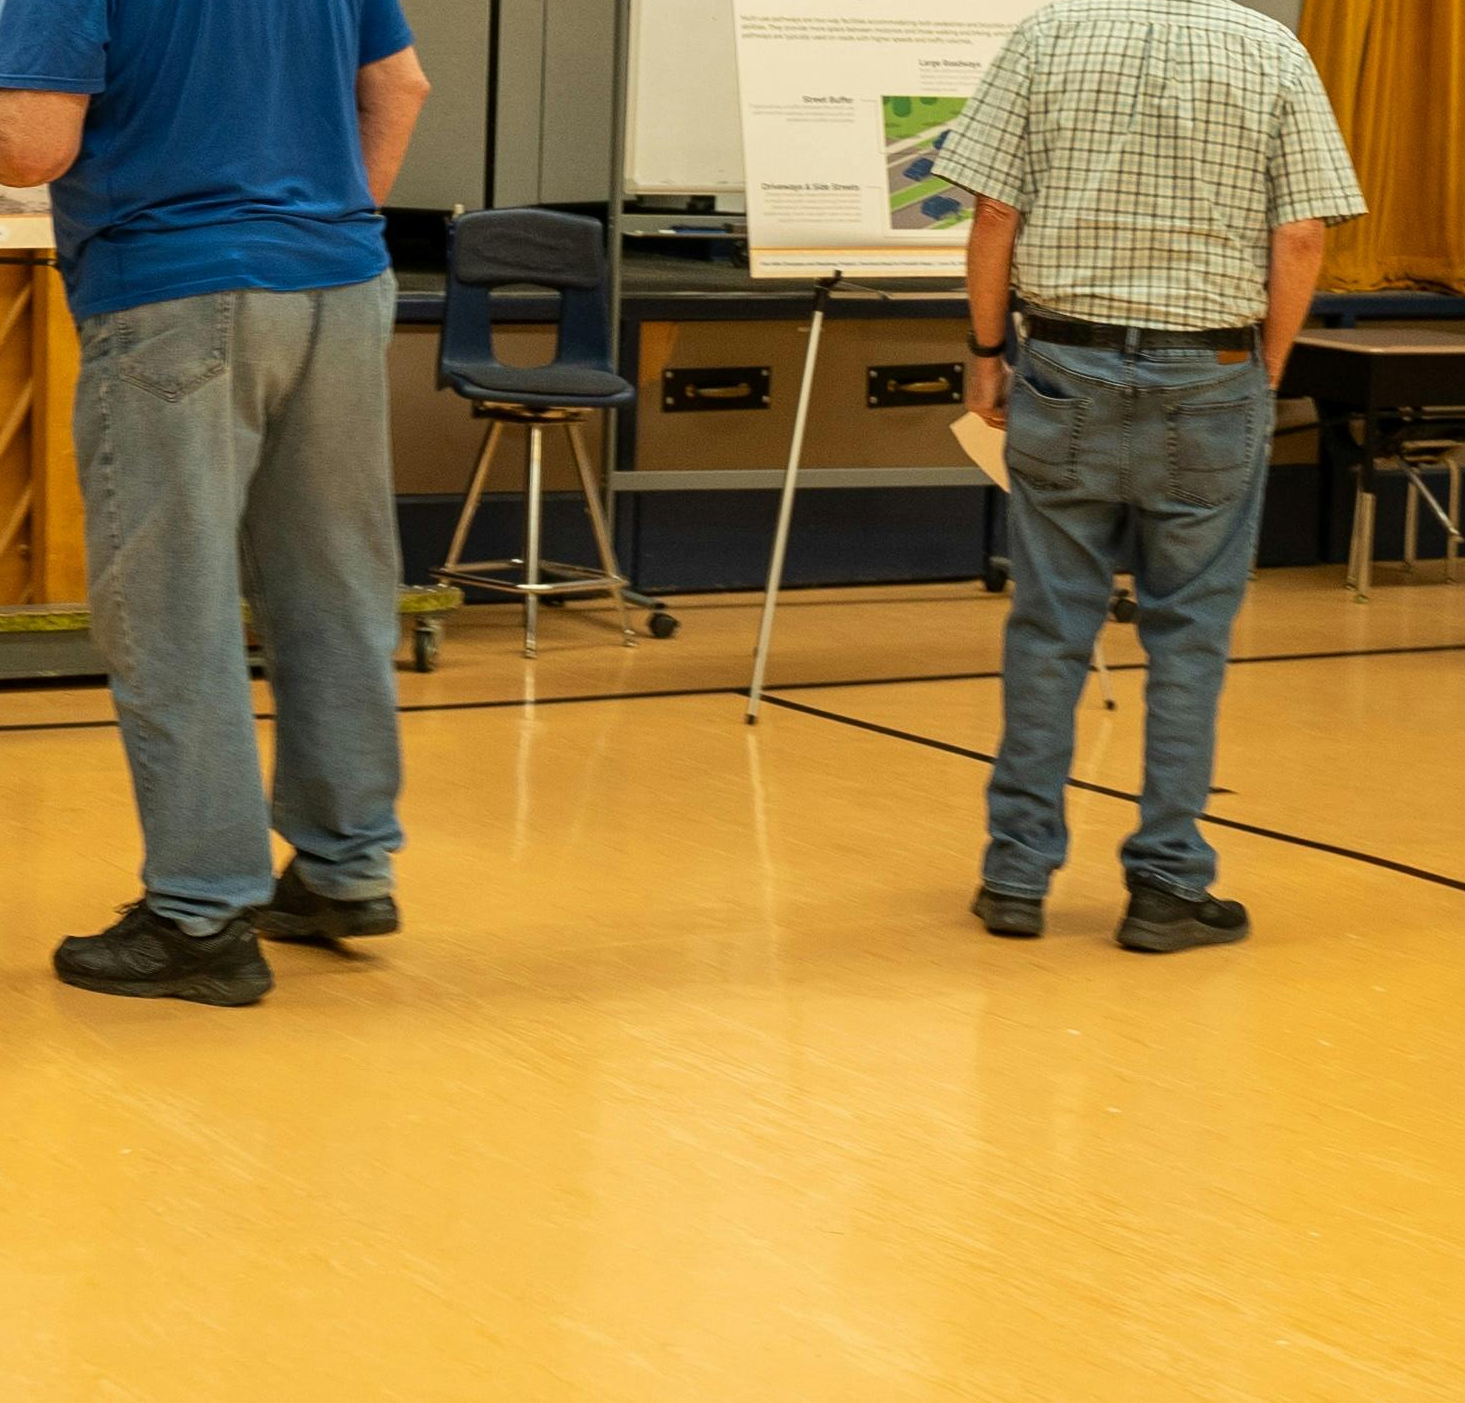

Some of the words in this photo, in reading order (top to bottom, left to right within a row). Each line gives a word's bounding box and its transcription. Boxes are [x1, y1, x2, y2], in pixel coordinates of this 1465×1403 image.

[918, 59, 940, 68] Large
[942, 59, 982, 69] Roadways
[802, 95, 827, 104] Street
[828, 96, 854, 104] Buffer
